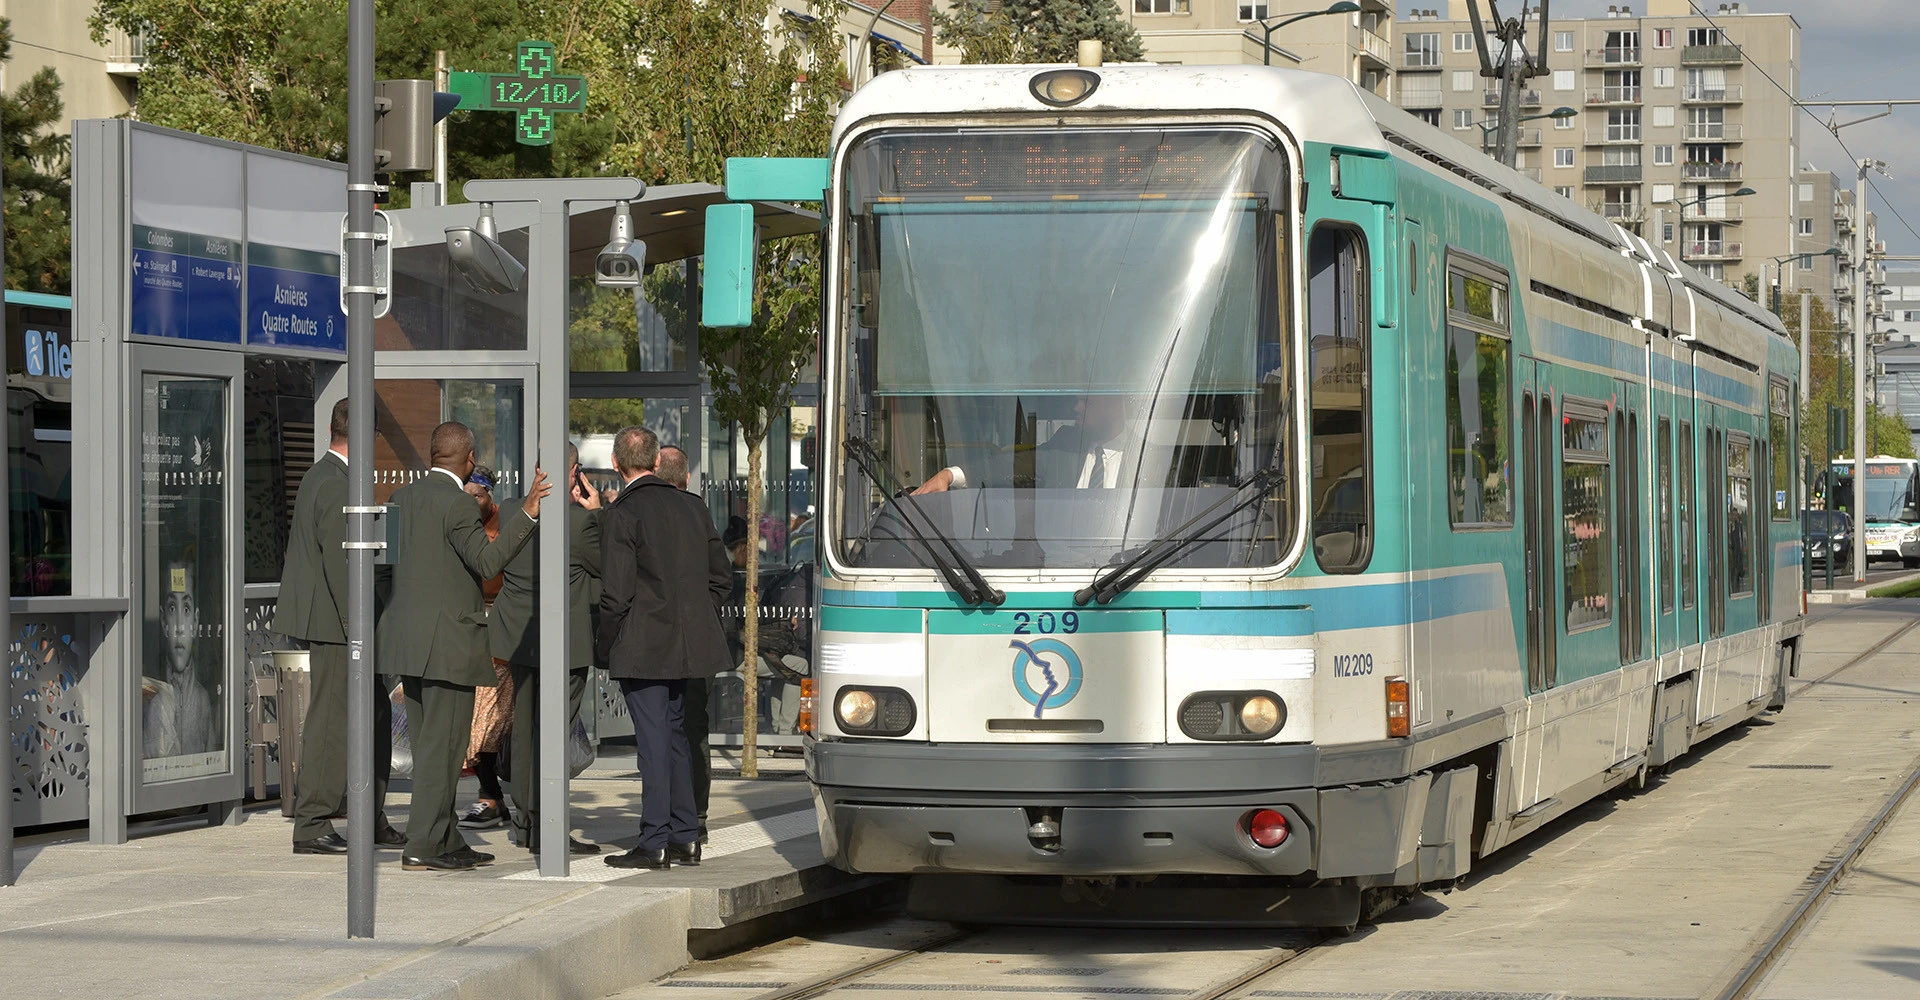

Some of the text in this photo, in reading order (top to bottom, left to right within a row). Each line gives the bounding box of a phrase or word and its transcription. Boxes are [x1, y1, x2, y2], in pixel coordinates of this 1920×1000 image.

[496, 82, 580, 104] 12/10/
[147, 230, 174, 248] Colombes
[205, 240, 228, 256] Asnières
[150, 260, 170, 273] Stalingrad
[195, 266, 208, 278] Robert
[274, 284, 308, 307] Asnières
[262, 310, 318, 336] Quatre Routes
[1884, 465, 1901, 475] RER
[1013, 611, 1079, 634] 209
